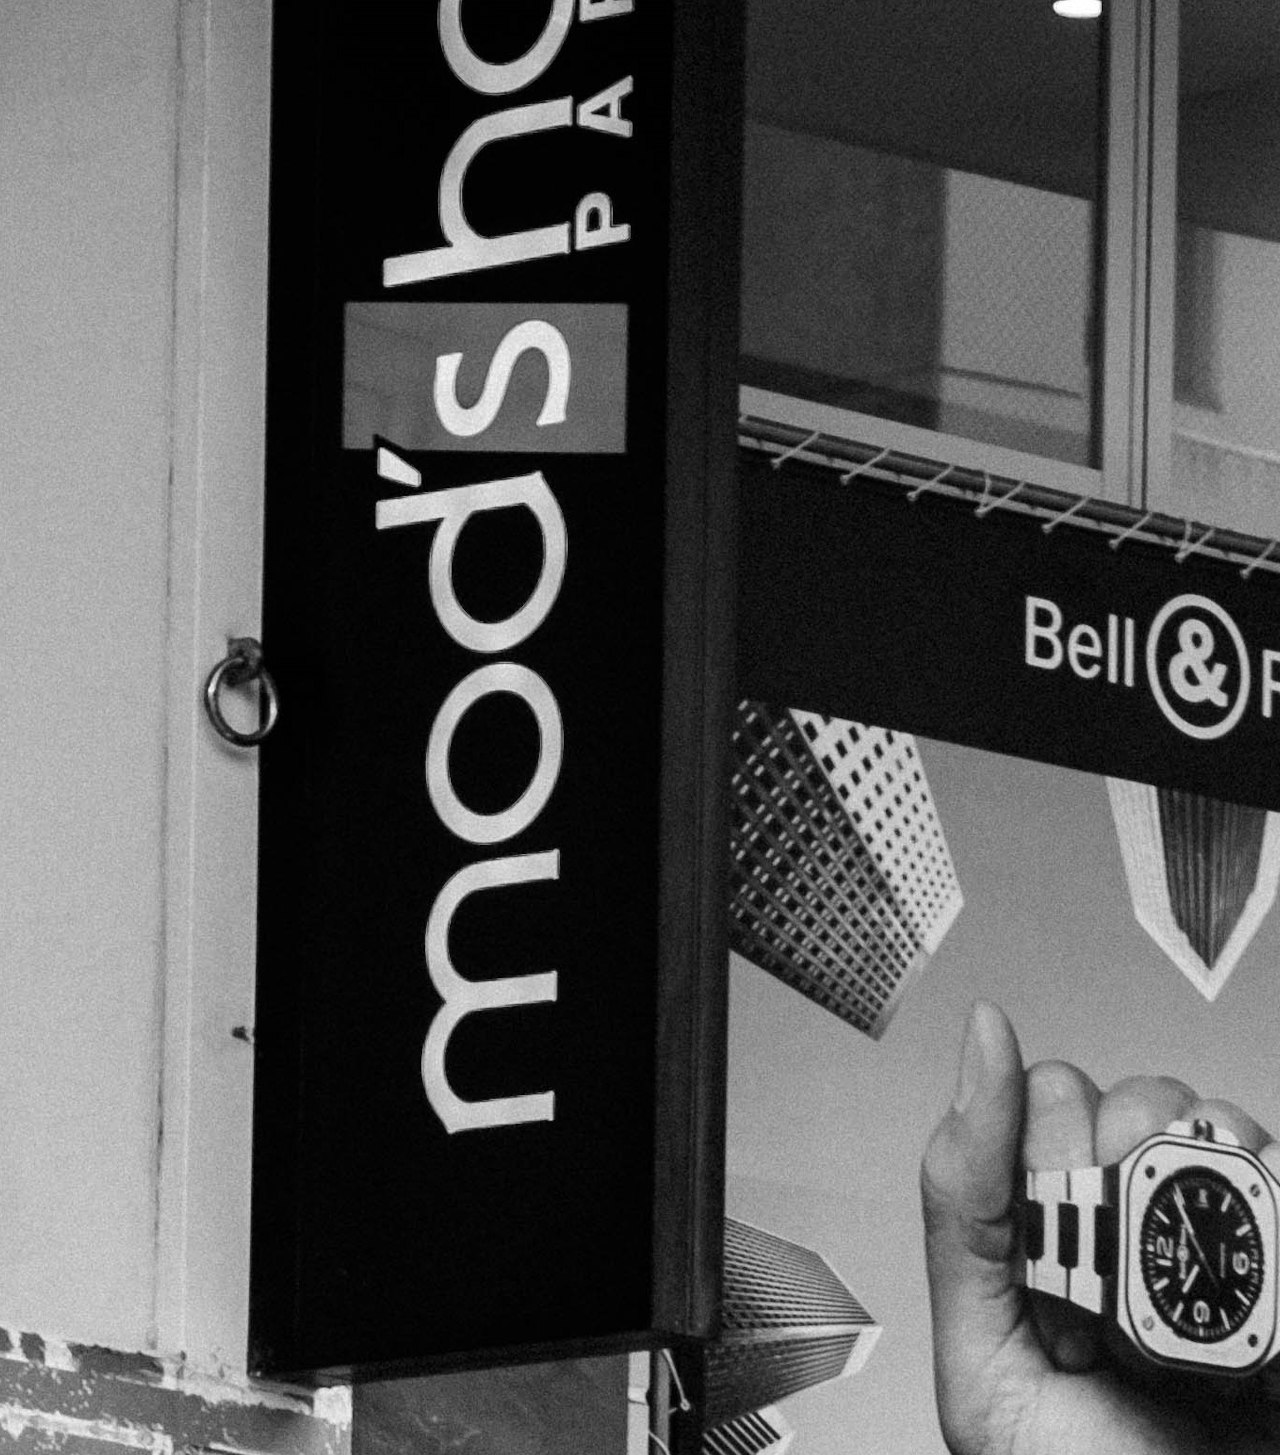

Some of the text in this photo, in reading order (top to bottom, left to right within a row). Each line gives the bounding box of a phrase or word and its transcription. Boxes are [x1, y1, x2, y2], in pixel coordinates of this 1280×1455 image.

[376, 319, 571, 1135] mod's
[1024, 595, 1135, 688] Bell
[1168, 617, 1229, 708] &
